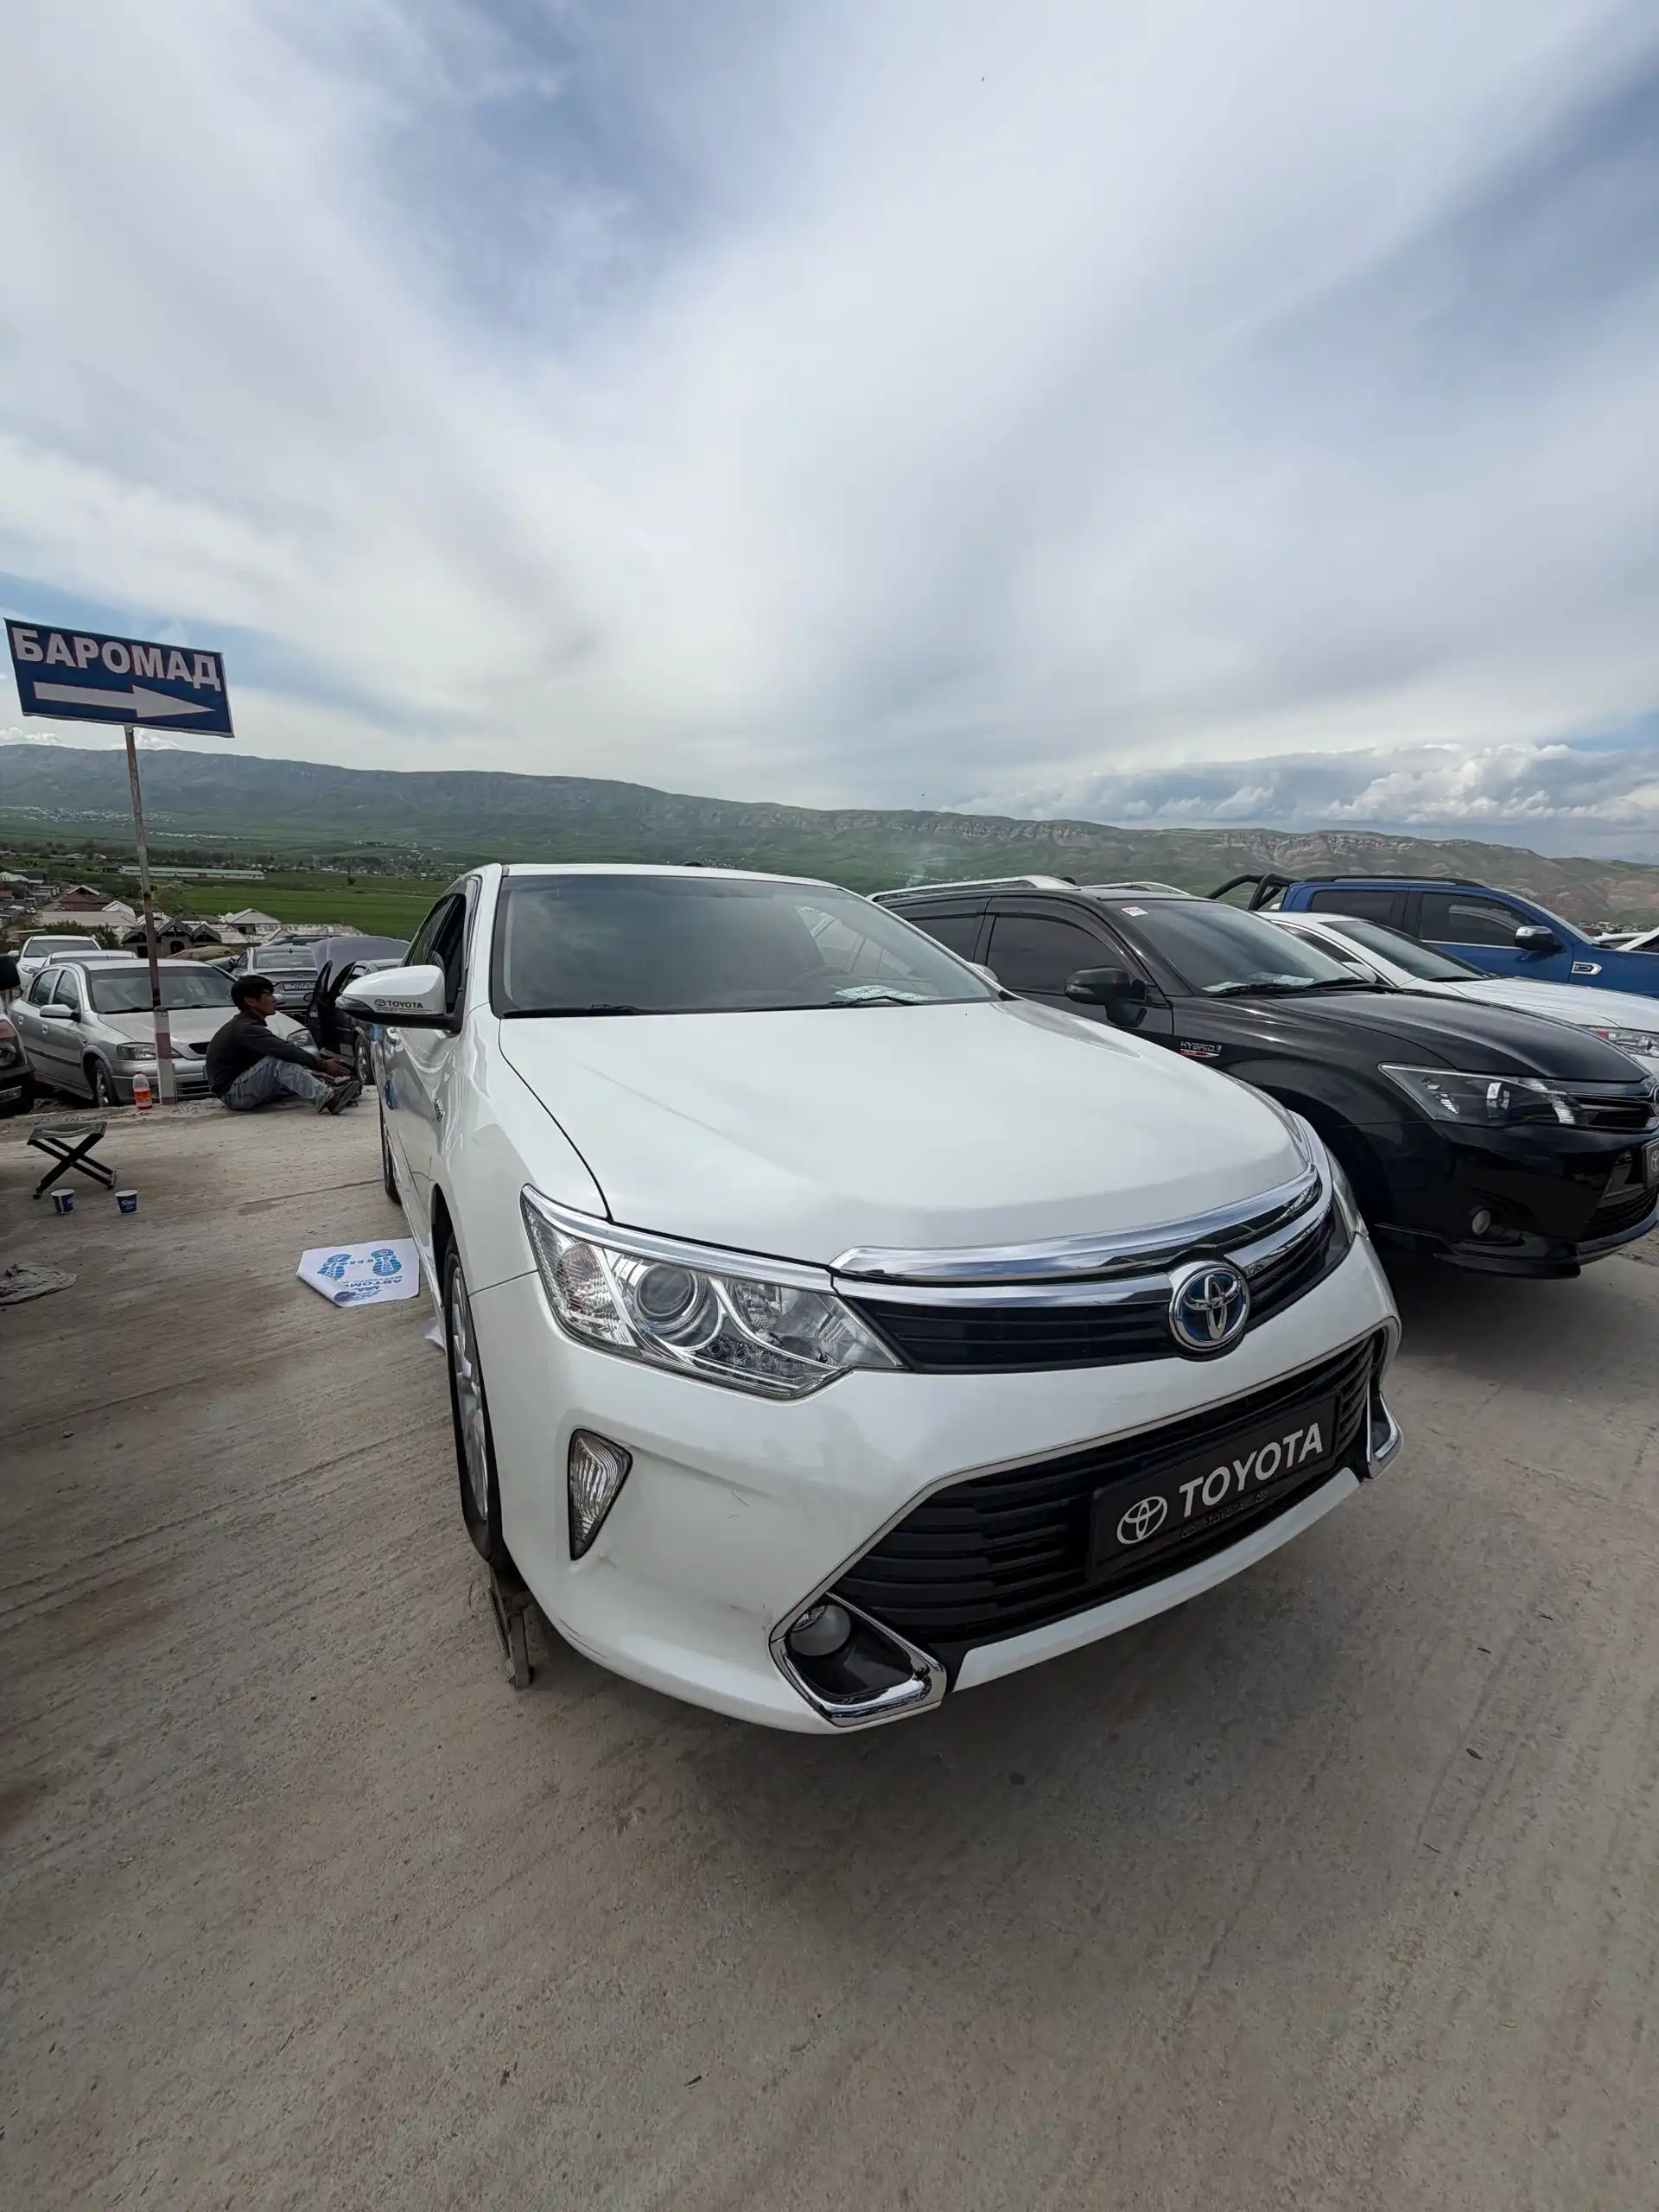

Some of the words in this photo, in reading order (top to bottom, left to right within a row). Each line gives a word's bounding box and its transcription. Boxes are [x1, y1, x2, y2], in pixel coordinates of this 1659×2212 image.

[11, 626, 222, 692] БАРОМАД
[386, 1000, 423, 1009] TOYOTA
[1178, 1422, 1324, 1518] TOYOTA
